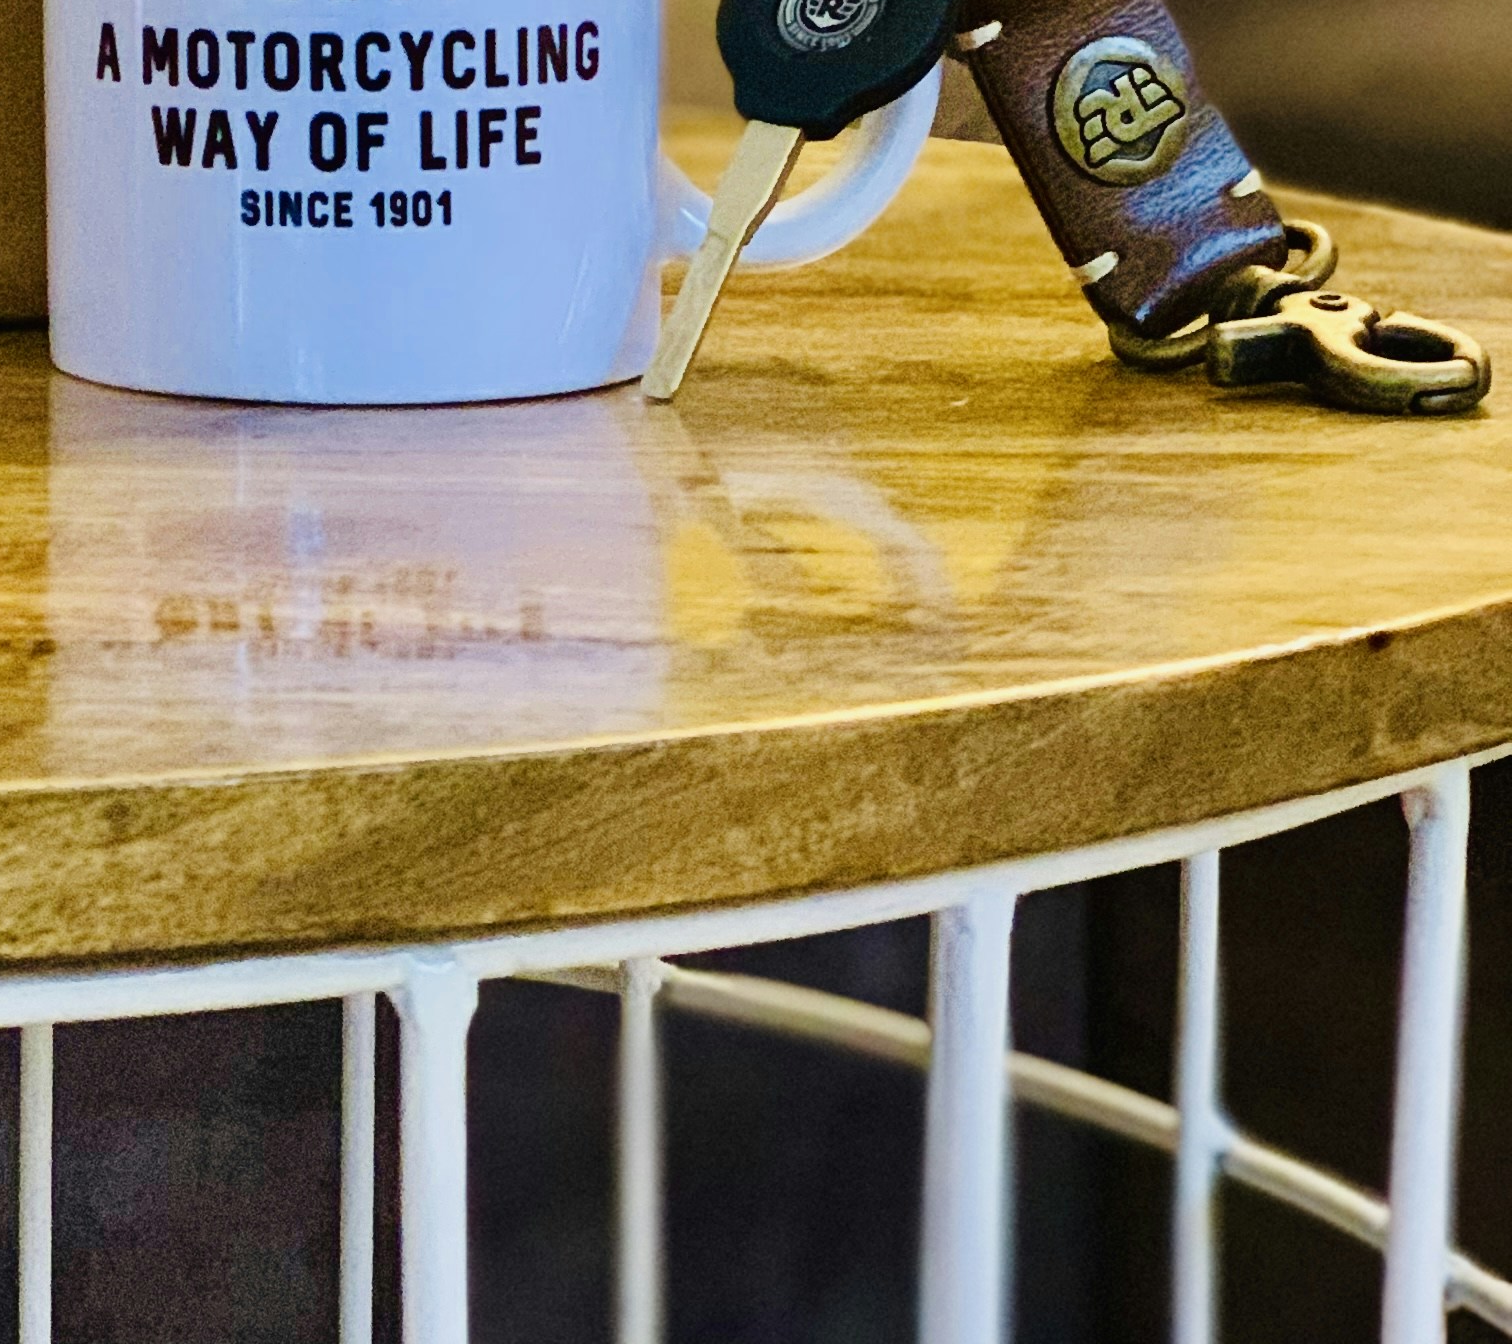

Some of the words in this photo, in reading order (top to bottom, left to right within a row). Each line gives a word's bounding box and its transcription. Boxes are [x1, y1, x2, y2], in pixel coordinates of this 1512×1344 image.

[96, 22, 122, 83] A
[141, 20, 600, 93] MOTORCYCLING
[151, 105, 280, 172] WAY
[308, 110, 389, 173] OF
[419, 105, 542, 171] LIFE
[240, 188, 354, 229] SINCE
[368, 189, 452, 228] 1901
